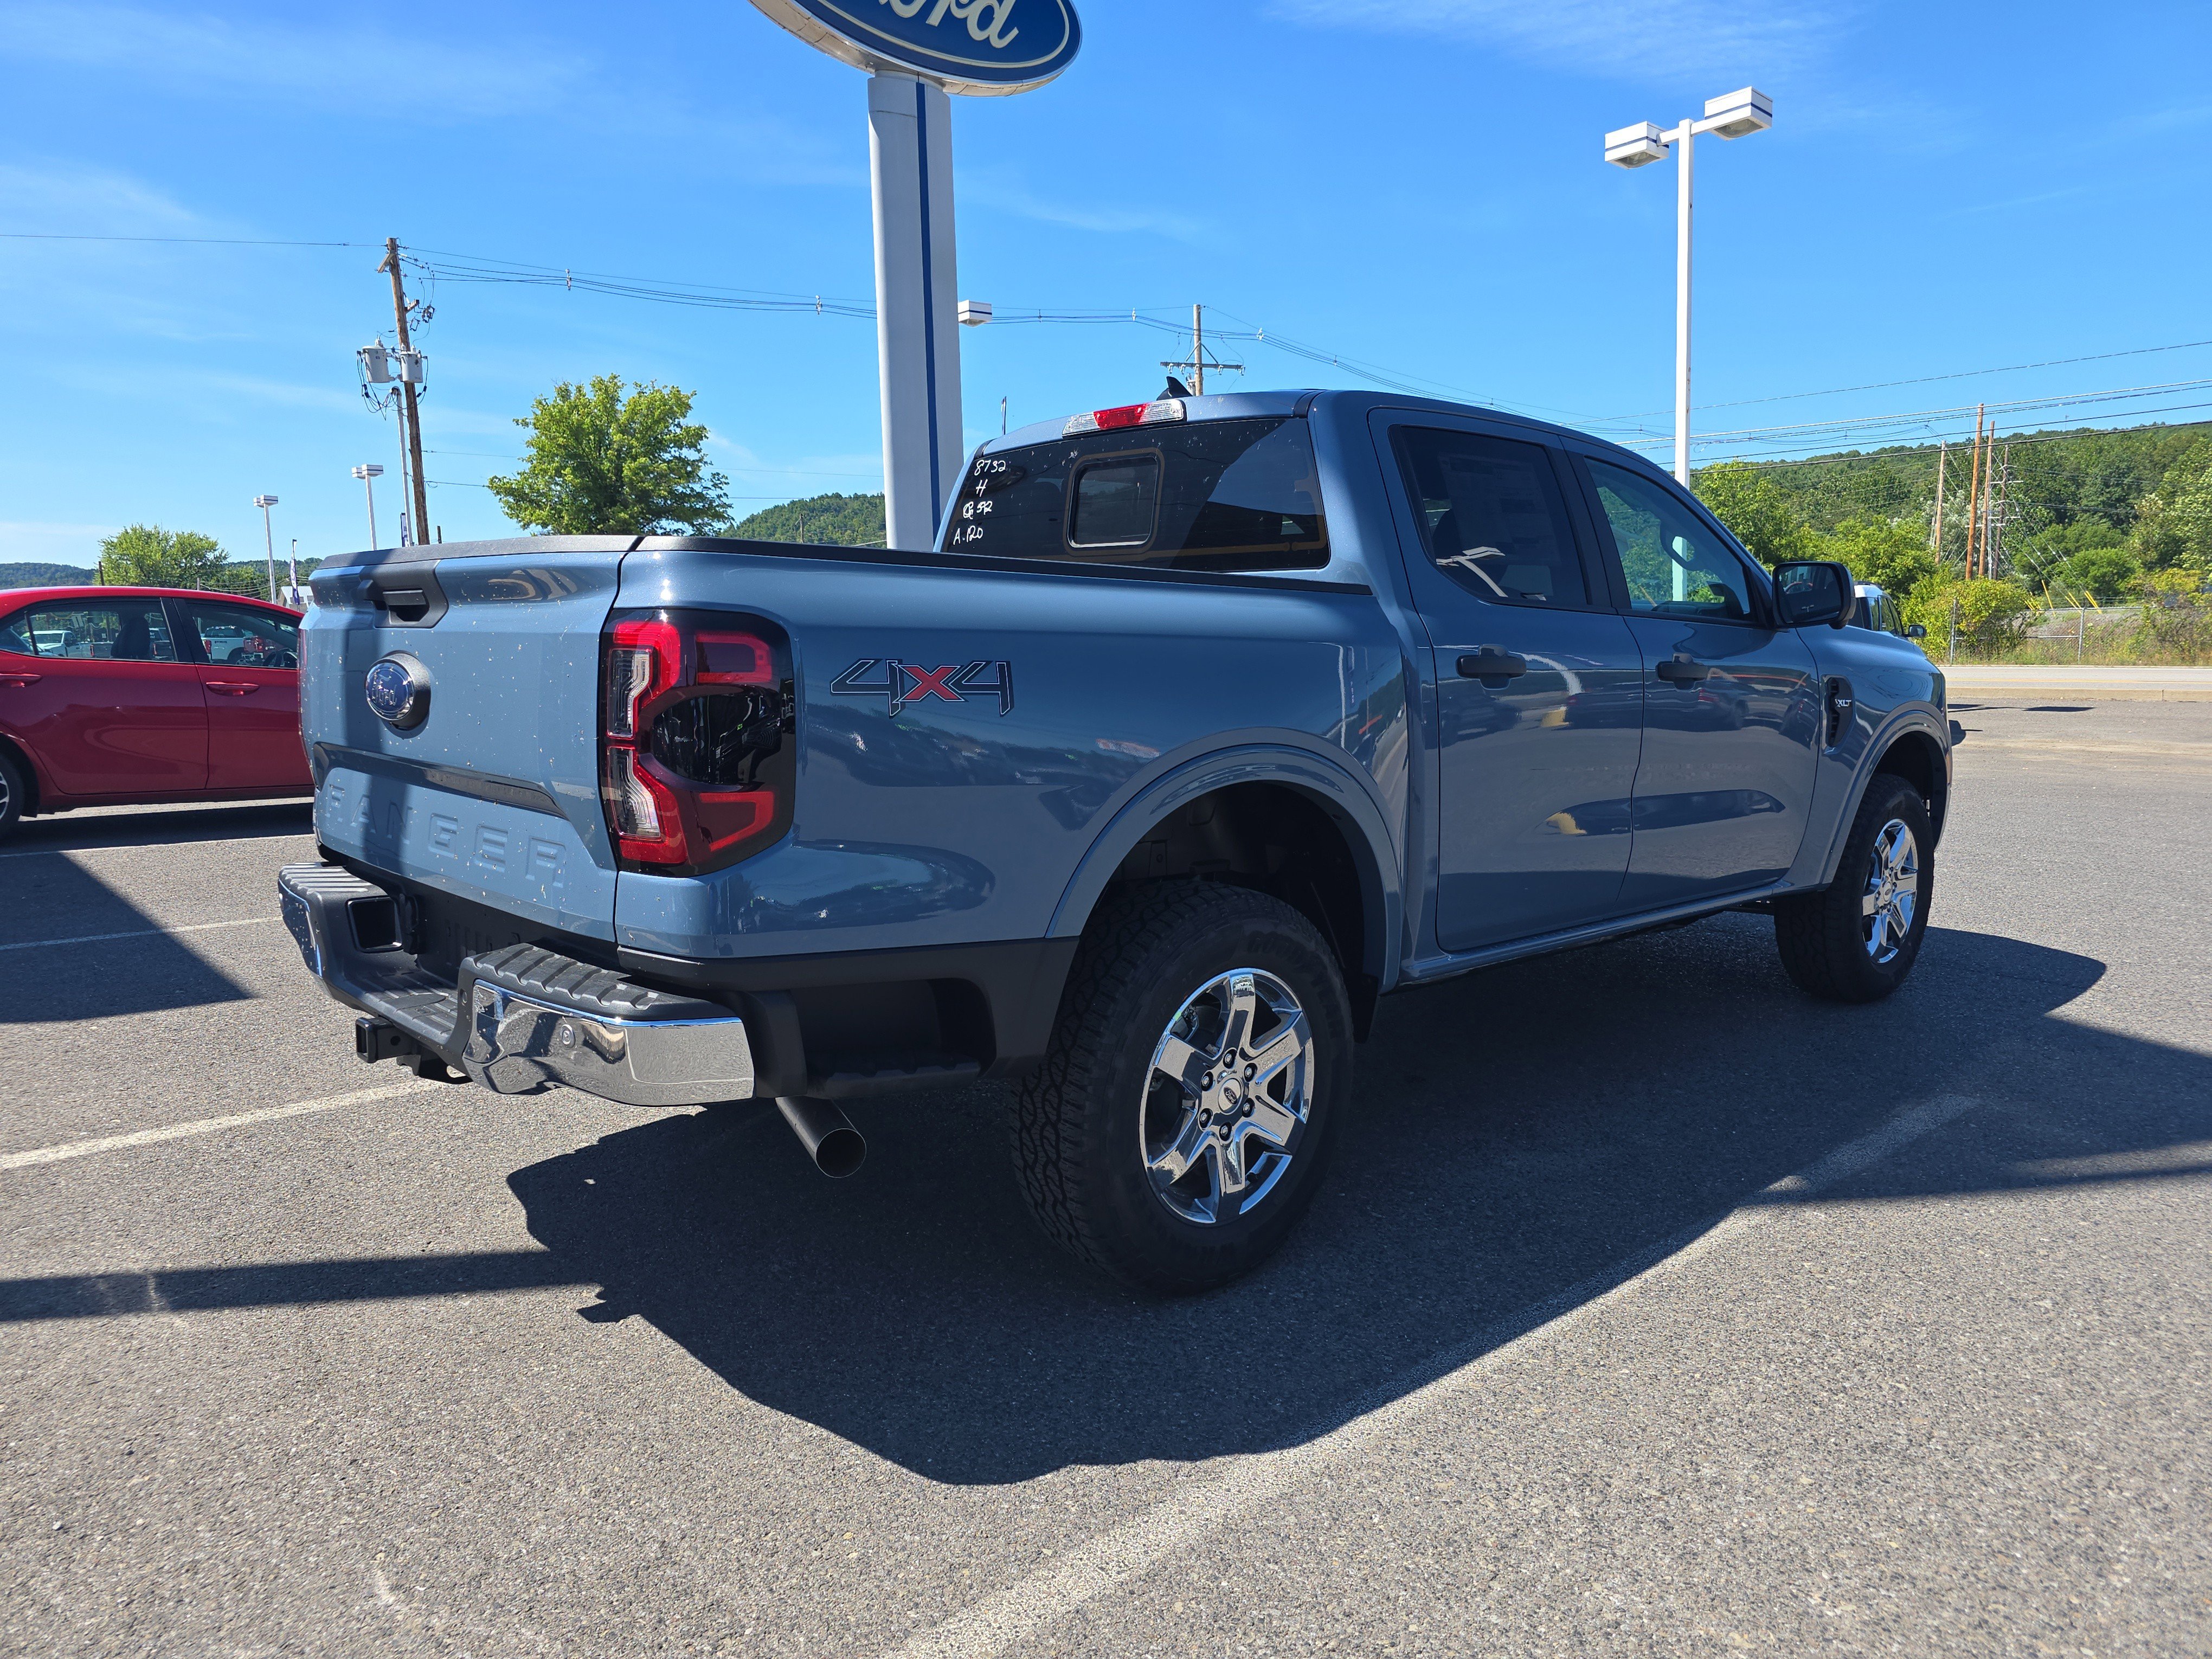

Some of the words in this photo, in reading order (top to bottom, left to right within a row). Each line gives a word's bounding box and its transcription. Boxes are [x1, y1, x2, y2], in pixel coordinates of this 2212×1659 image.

[879, 0, 1019, 49] rd
[1835, 698, 1852, 708] XLT
[1225, 1090, 1237, 1104] Ford
